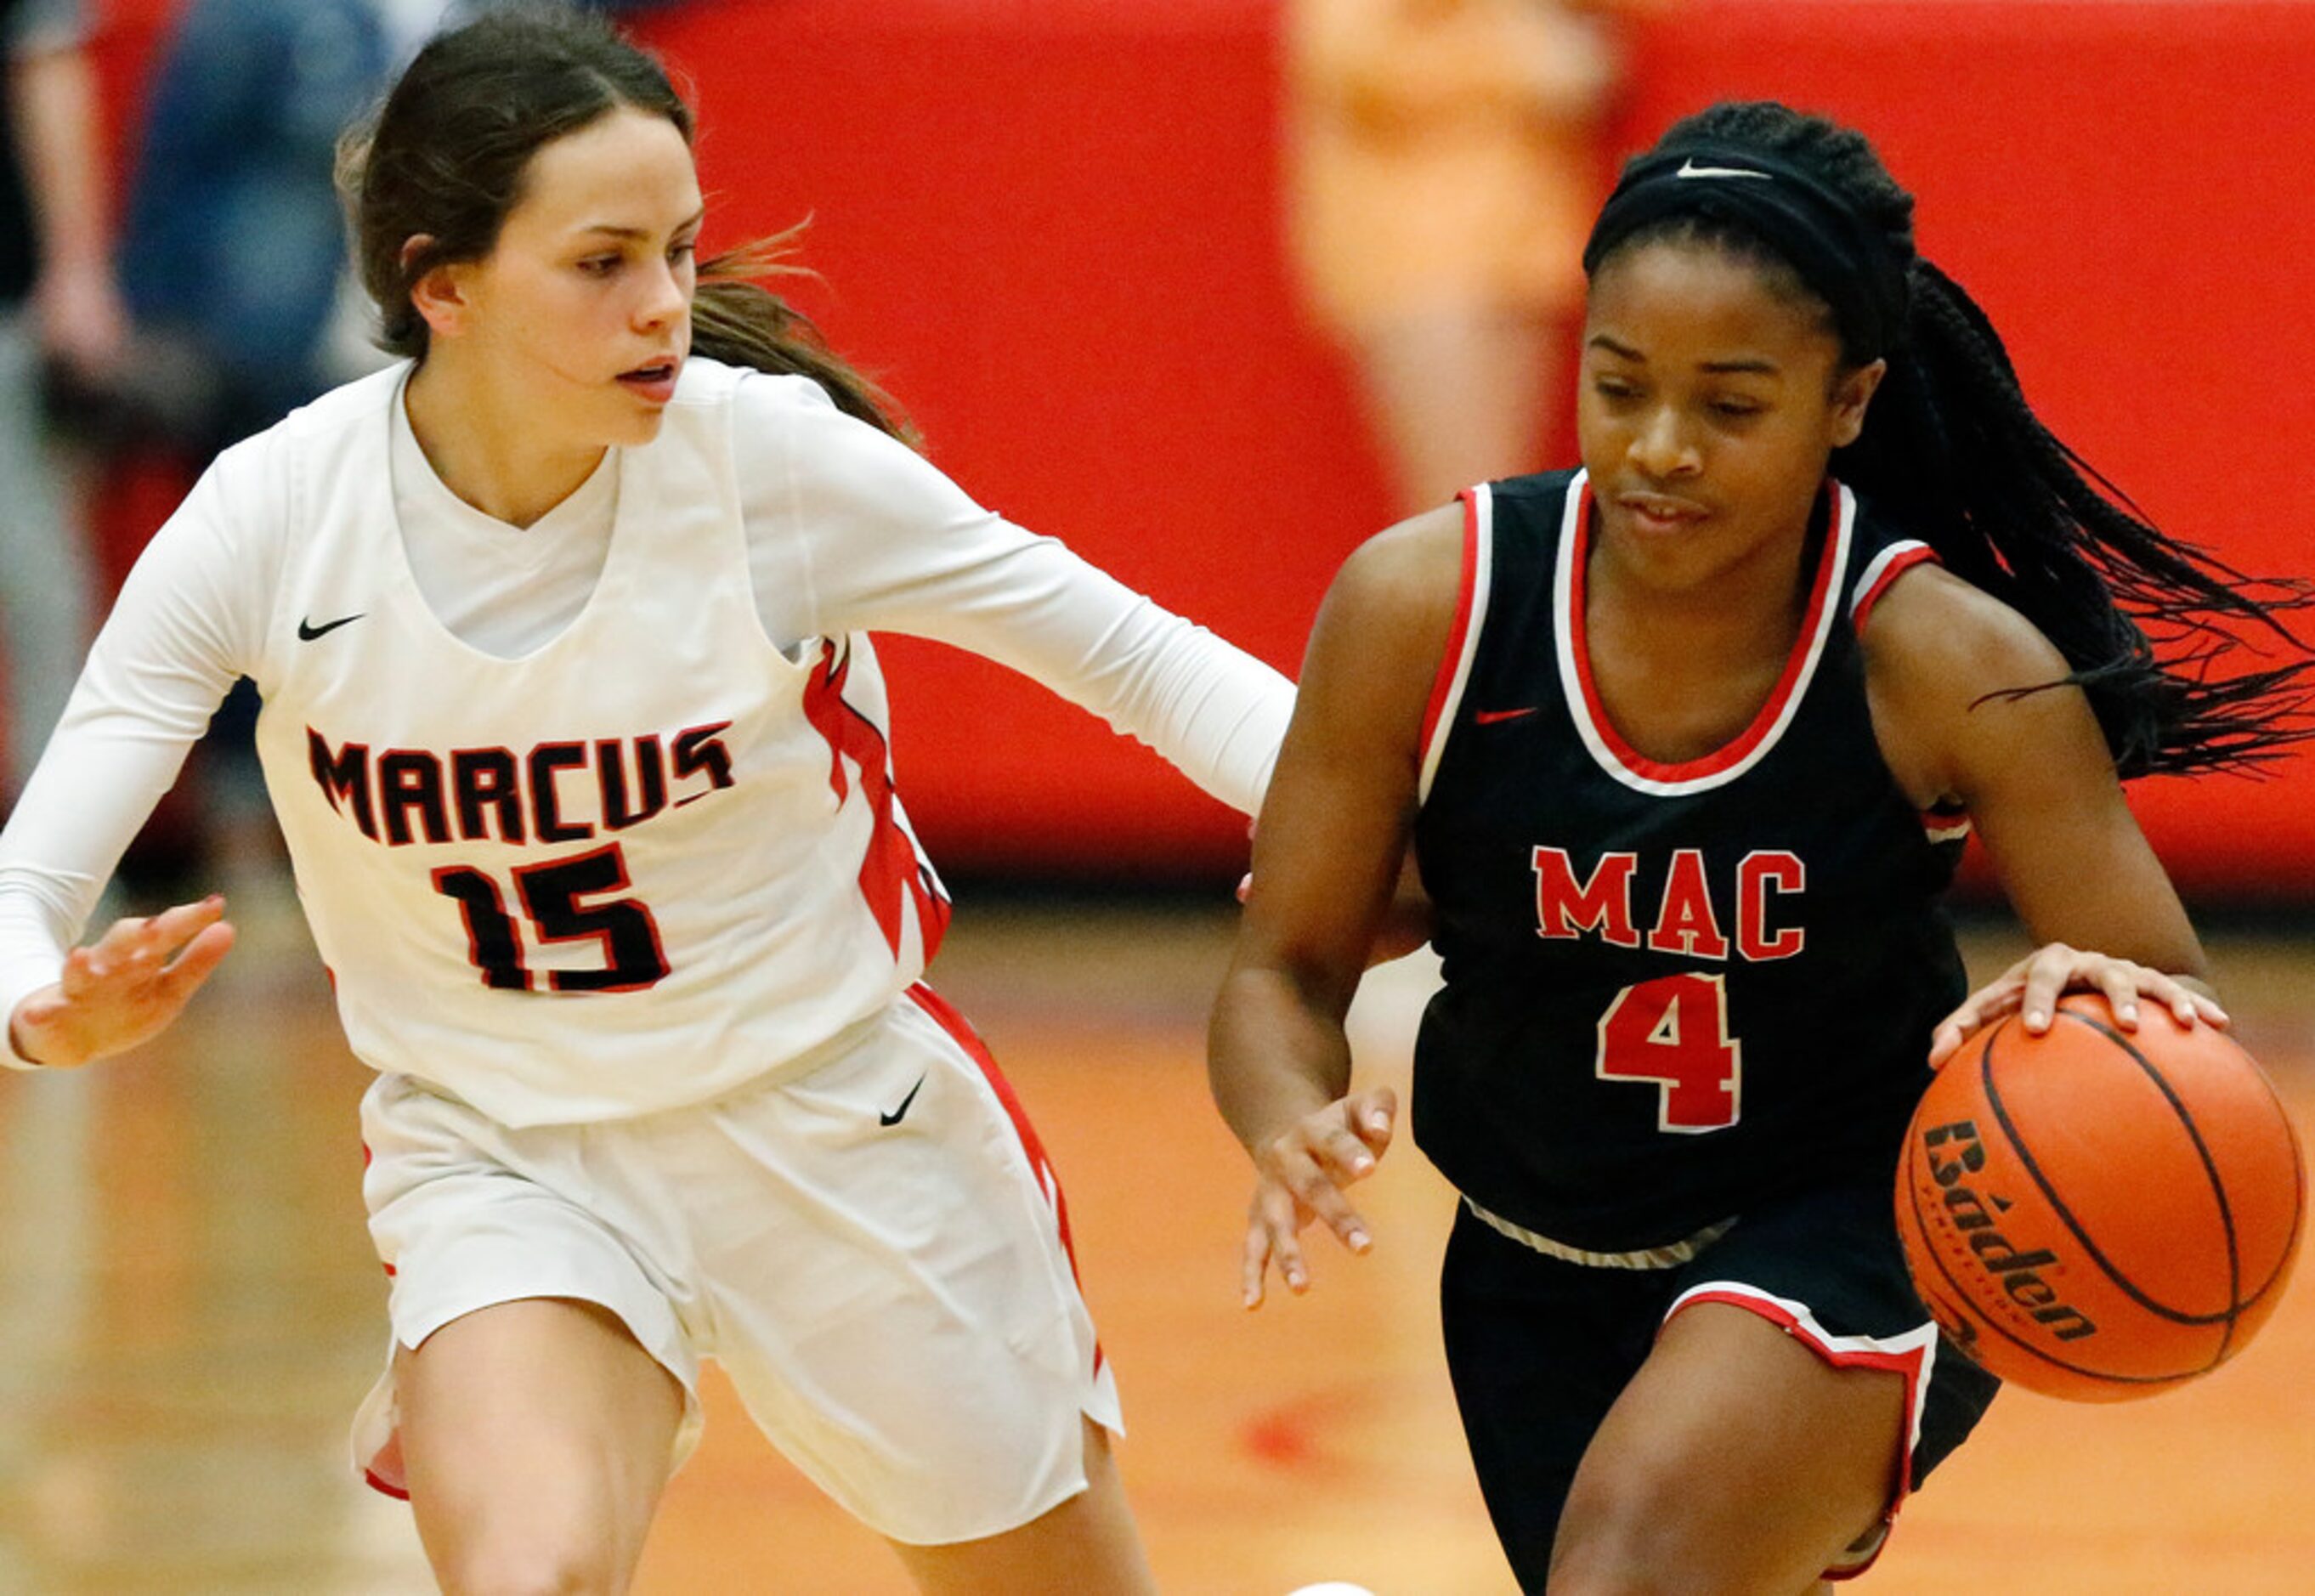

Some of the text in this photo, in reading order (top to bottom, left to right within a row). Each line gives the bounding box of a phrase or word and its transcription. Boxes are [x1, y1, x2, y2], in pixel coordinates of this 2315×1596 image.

[306, 721, 735, 846] MARCUS
[430, 840, 672, 993] 15
[1531, 845, 1806, 962] MAC
[1595, 971, 1742, 1135] 4
